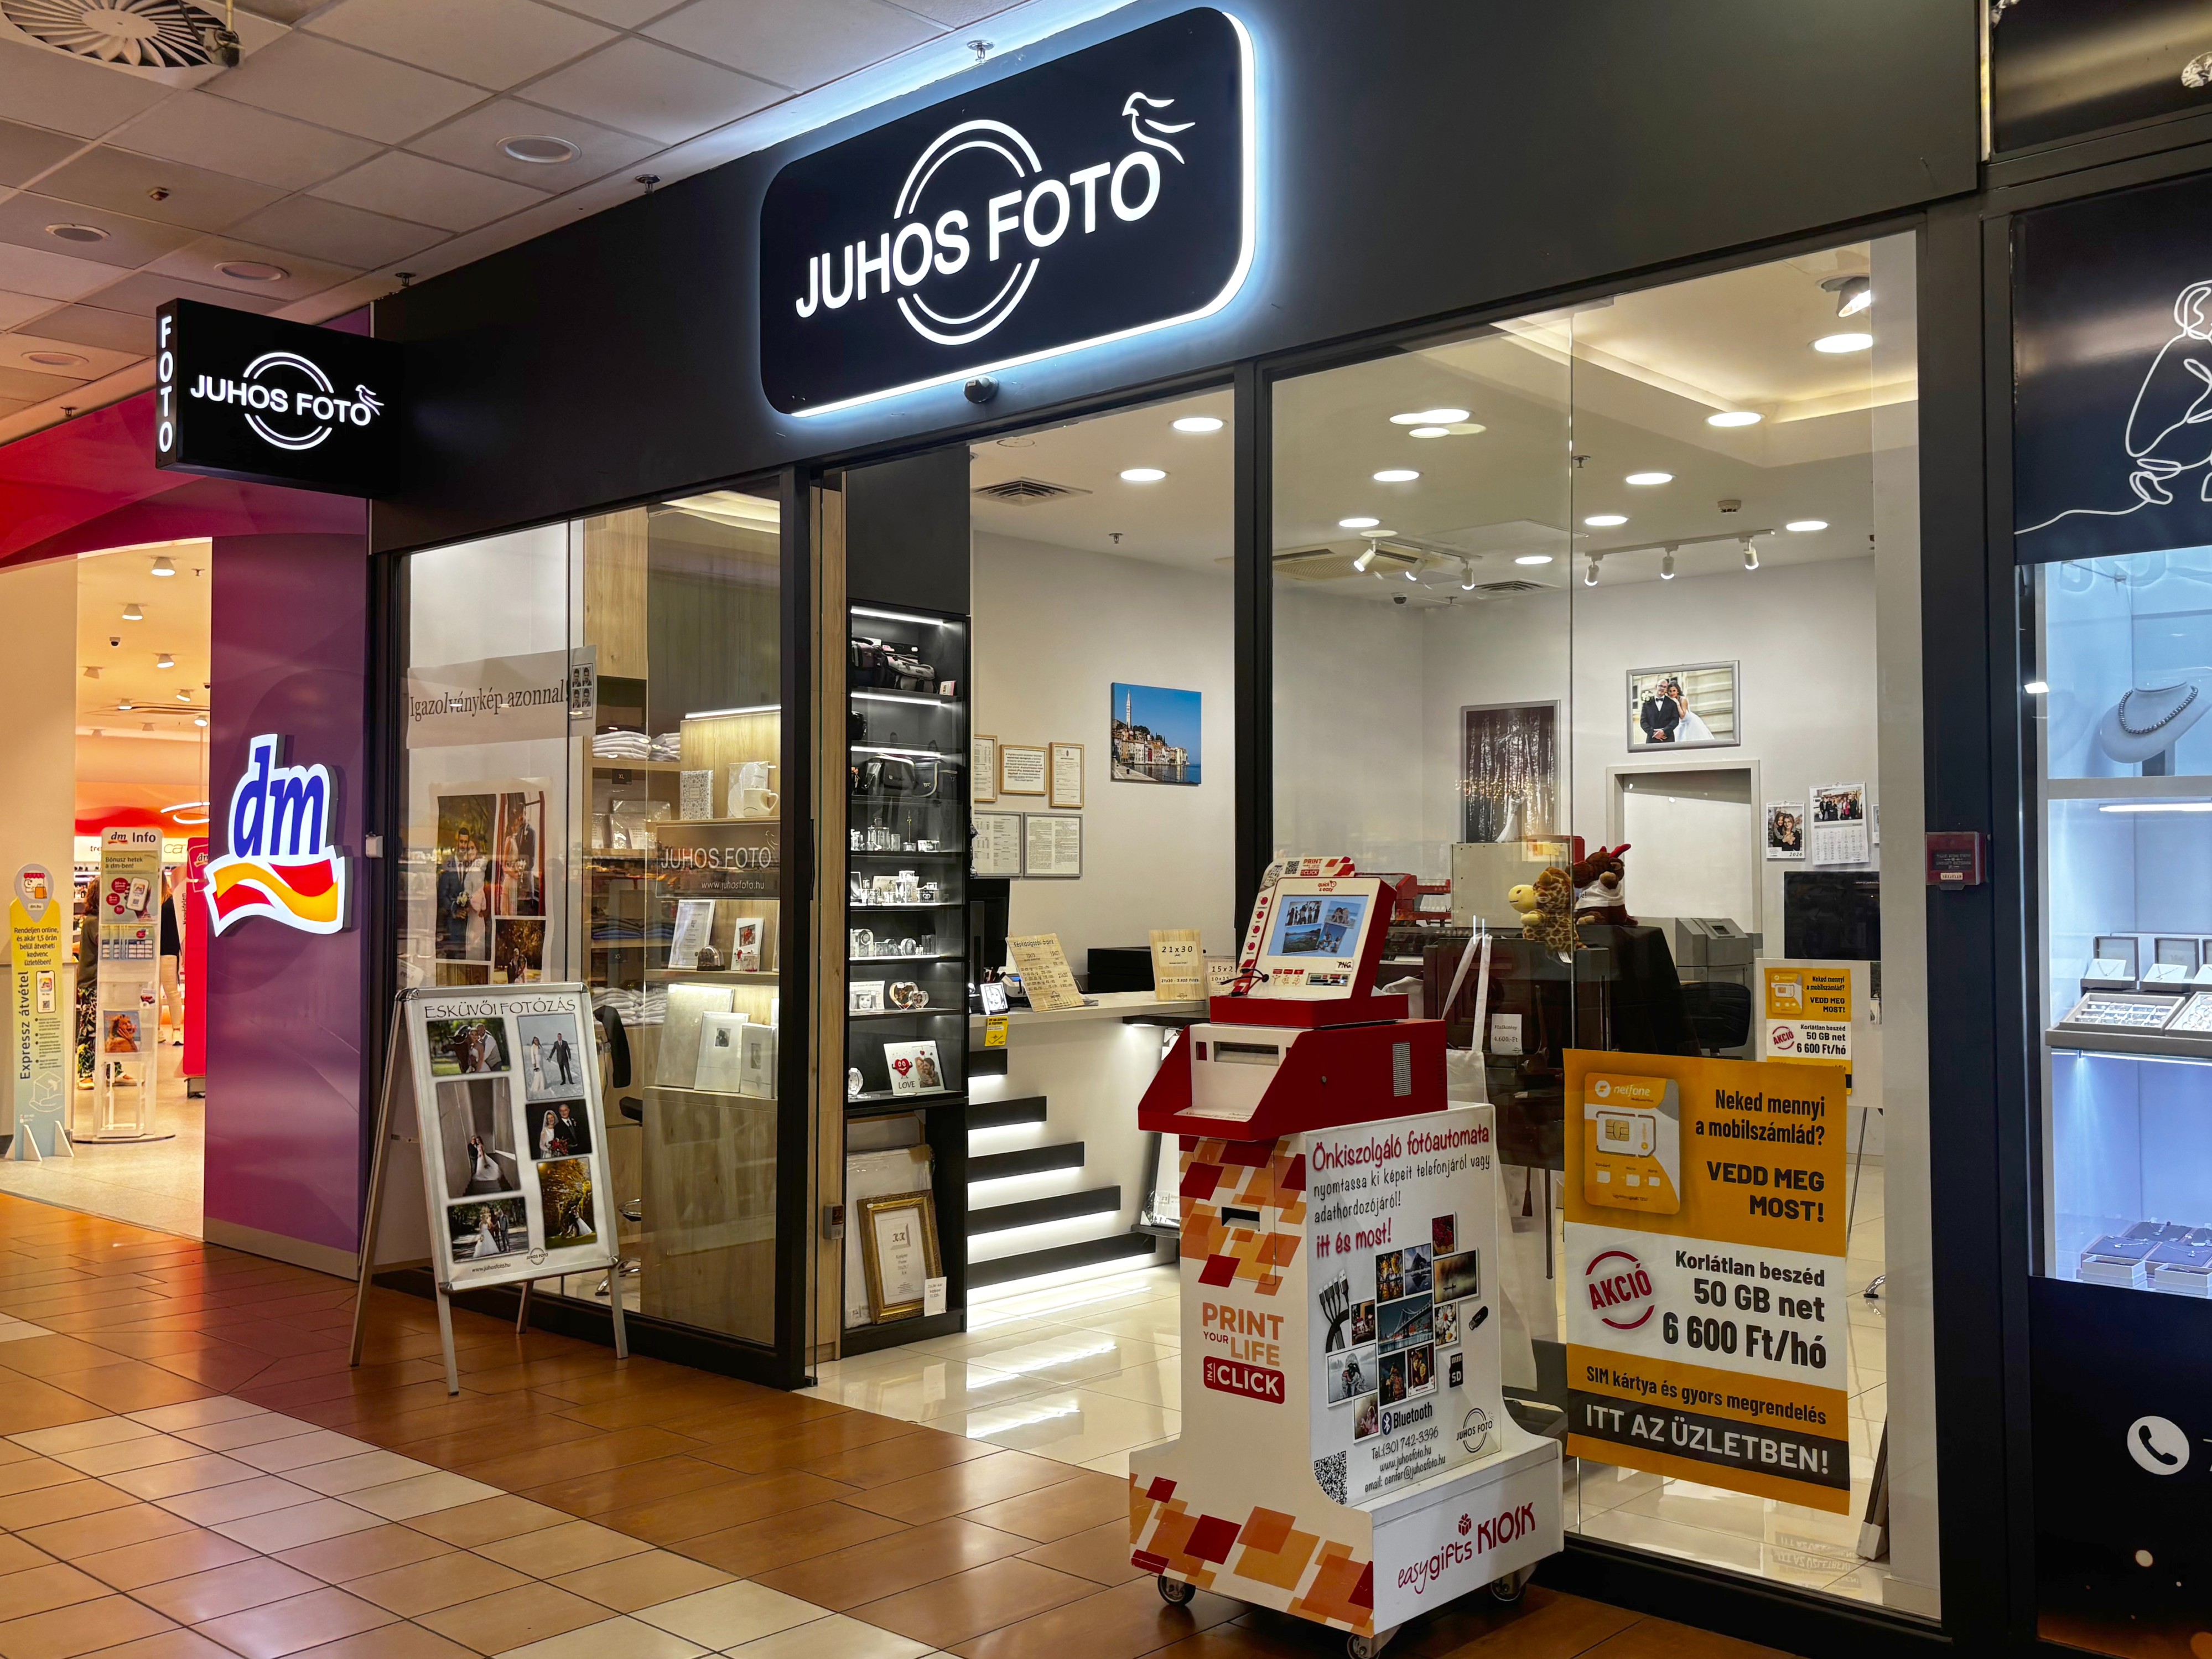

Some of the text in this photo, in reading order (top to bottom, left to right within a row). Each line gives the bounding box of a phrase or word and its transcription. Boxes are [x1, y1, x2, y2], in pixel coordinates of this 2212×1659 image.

[796, 151, 1161, 318] JUHOS FOTO
[159, 315, 173, 453] FOTO
[190, 375, 371, 426] JUHOS FOTO
[410, 687, 503, 722] Igazolványkép
[233, 745, 324, 858] dm
[111, 832, 156, 843] dm Info
[661, 847, 771, 869] JUHOS FOTO
[701, 880, 765, 891] www.juhosfoto.hu
[424, 997, 576, 1019] ESKÜVŐI FOTÓZÁS
[18, 971, 33, 1080] Expressz átvétel
[1773, 1028, 1794, 1045] AKCIÓ
[1806, 1031, 1816, 1040] 50
[1797, 1043, 1846, 1055] 6 600 Ft/hó
[899, 1081, 915, 1089] LOVE
[1716, 1089, 1825, 1122] Neked mennyi
[1312, 1123, 1489, 1171] Önkiszolgáló fotóautomata
[1696, 1119, 1825, 1145] a mobilszámlád?
[1314, 1154, 1491, 1201] nyomtassa ki képeit telefonjáról vagy
[1707, 1161, 1825, 1192] VEDD MEG
[1315, 1190, 1401, 1223] adathordozójáról!
[1750, 1195, 1824, 1223] MOST!
[1317, 1217, 1391, 1258] itt és most!
[1675, 1251, 1825, 1287] Korlátlan beszéd
[1588, 1263, 1652, 1310] AKCIÓ
[1694, 1278, 1825, 1322] 50 GB net
[1202, 1302, 1284, 1341] PRINT
[1203, 1331, 1280, 1367] YOUR LIFE
[1663, 1311, 1826, 1369] 6 600 Ft/hó
[1217, 1365, 1280, 1397] CLICK
[1451, 1371, 1461, 1383] SD
[1586, 1366, 1826, 1424] SIM kártya és gyors megrendelés
[1393, 1402, 1433, 1429] Bluetooth
[1456, 1420, 1493, 1441] JUHOS FOTO
[1400, 1426, 1439, 1449] 742-3396
[1586, 1404, 1829, 1475] ITT AZ ÜZLETBEN!
[1379, 1444, 1432, 1472] www.juhosfoto.hu
[1365, 1475, 1383, 1492] email:
[1477, 1502, 1535, 1554] KIOSK
